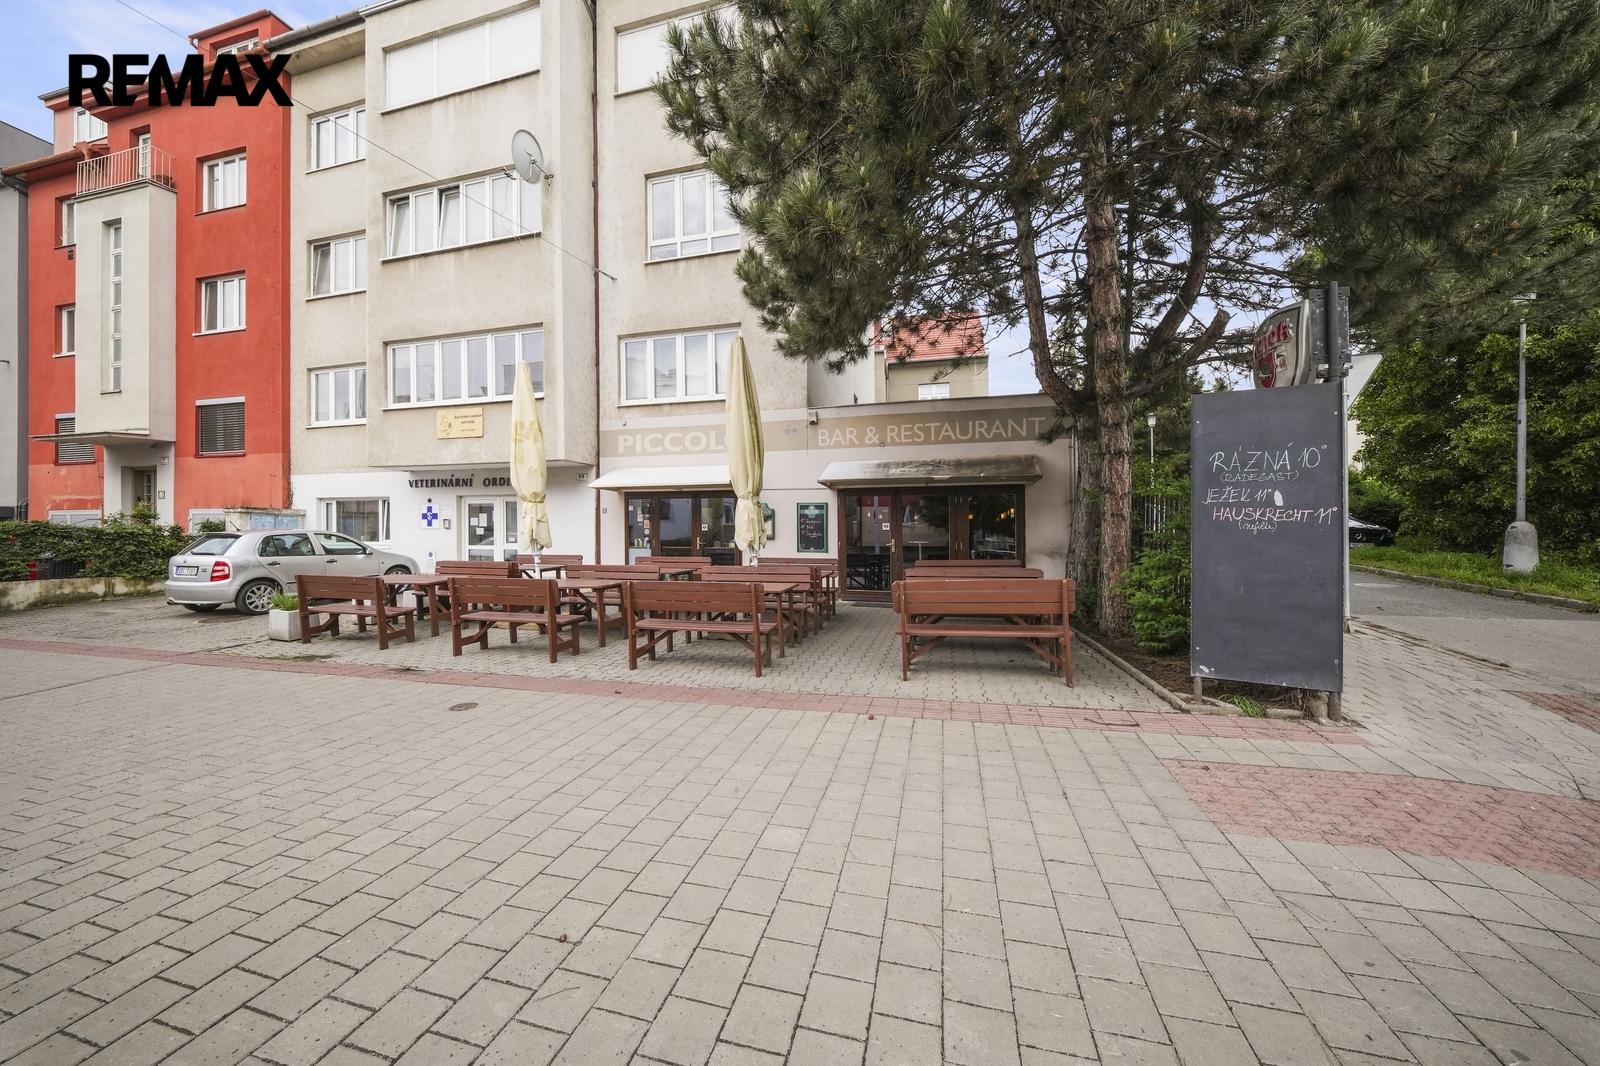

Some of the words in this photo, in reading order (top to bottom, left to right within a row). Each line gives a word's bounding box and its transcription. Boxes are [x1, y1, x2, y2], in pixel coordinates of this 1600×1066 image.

[617, 430, 729, 454] PICCOL
[818, 427, 859, 447] BAR
[864, 426, 880, 444] &
[887, 417, 1046, 443] RESTAURANT
[408, 474, 474, 488] VETERINÁRNÍ
[482, 477, 512, 487] ORDI
[1212, 507, 1313, 523] HAUSKRECHT
